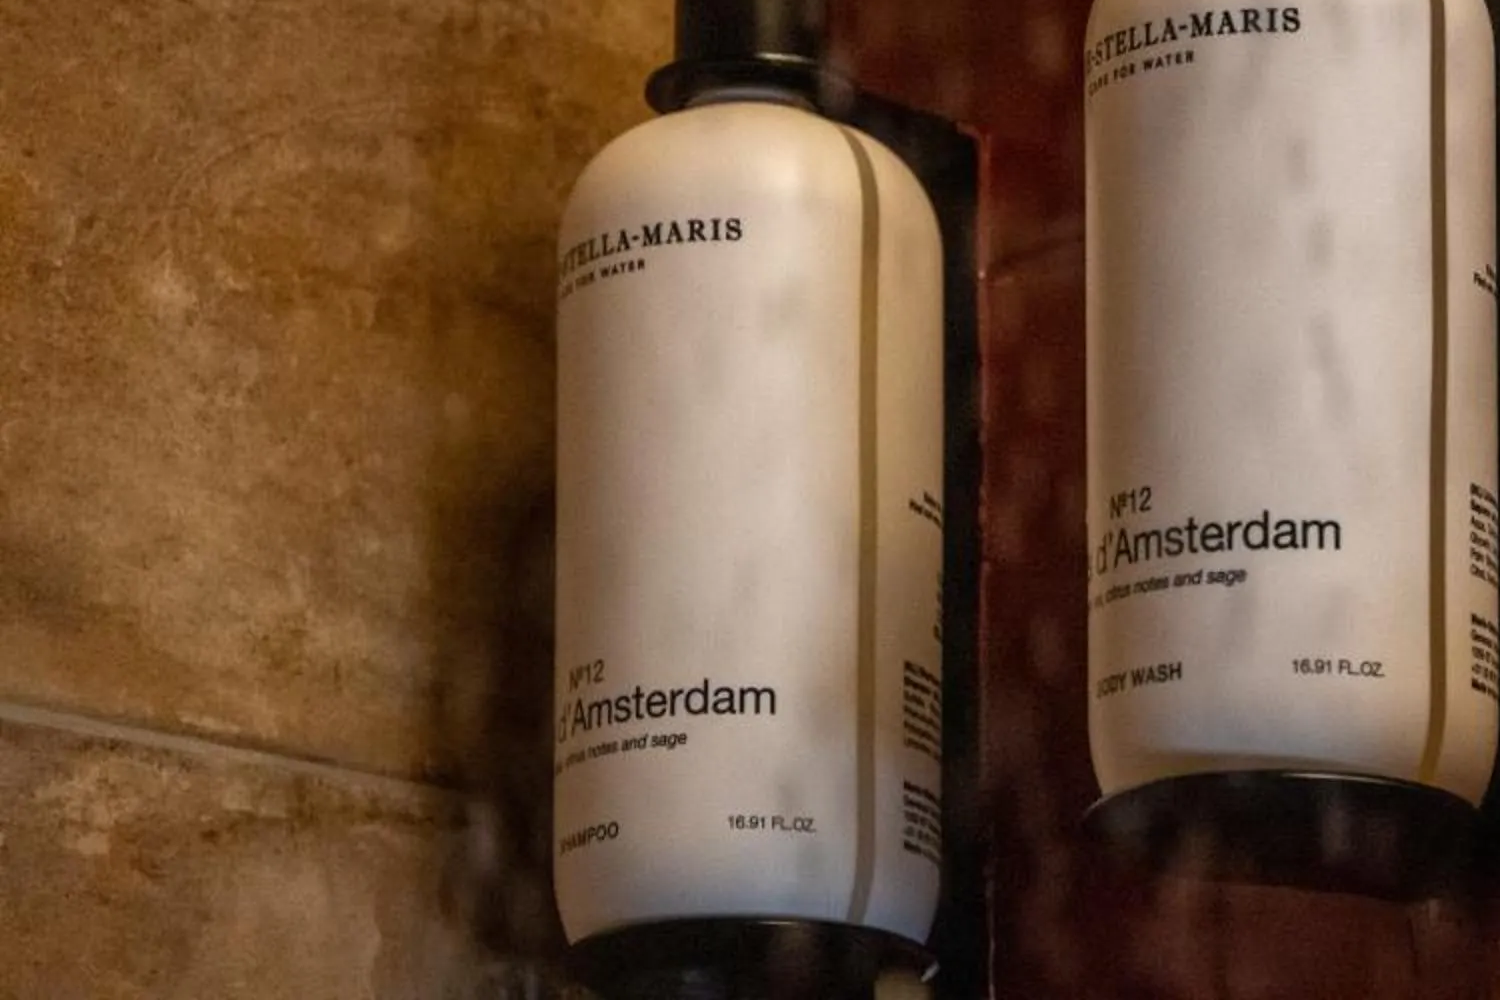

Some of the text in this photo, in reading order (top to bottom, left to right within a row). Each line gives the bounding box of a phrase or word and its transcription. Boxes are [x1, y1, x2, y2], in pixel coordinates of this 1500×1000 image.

[1143, 50, 1195, 71] WATER
[600, 258, 645, 279] WATER
[1173, 569, 1202, 587] and
[1206, 567, 1248, 591] sage
[1130, 661, 1183, 688] WASH
[1292, 658, 1332, 675] 16.91
[621, 734, 648, 752] and
[650, 731, 688, 749] sage
[728, 814, 766, 831] 16.91
